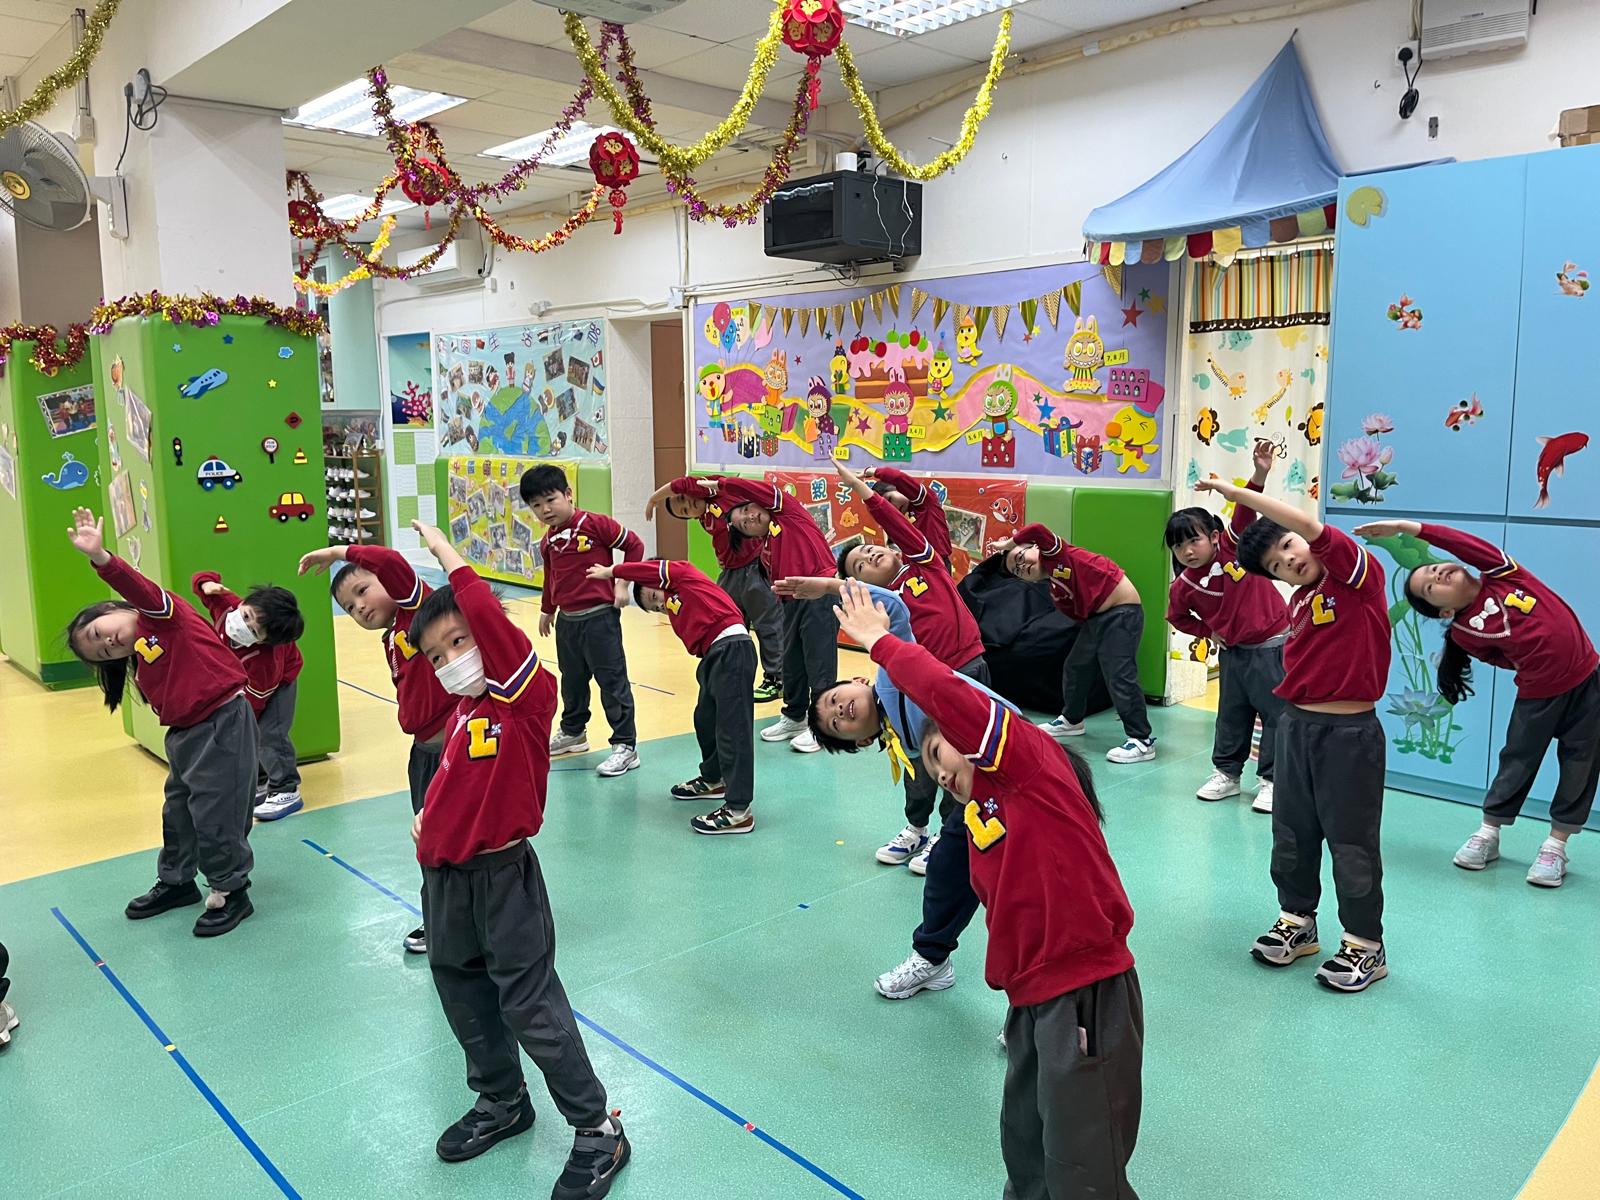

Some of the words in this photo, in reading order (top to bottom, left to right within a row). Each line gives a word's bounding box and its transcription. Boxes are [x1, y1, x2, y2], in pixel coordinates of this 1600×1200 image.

[577, 535, 591, 552] L
[1053, 567, 1072, 579] L
[1223, 561, 1246, 582] L
[904, 576, 929, 597] L
[1311, 594, 1335, 625] L
[1503, 592, 1537, 614] L
[134, 636, 165, 664] L
[394, 630, 418, 660] L
[466, 717, 498, 759] L
[964, 799, 1007, 851] L
